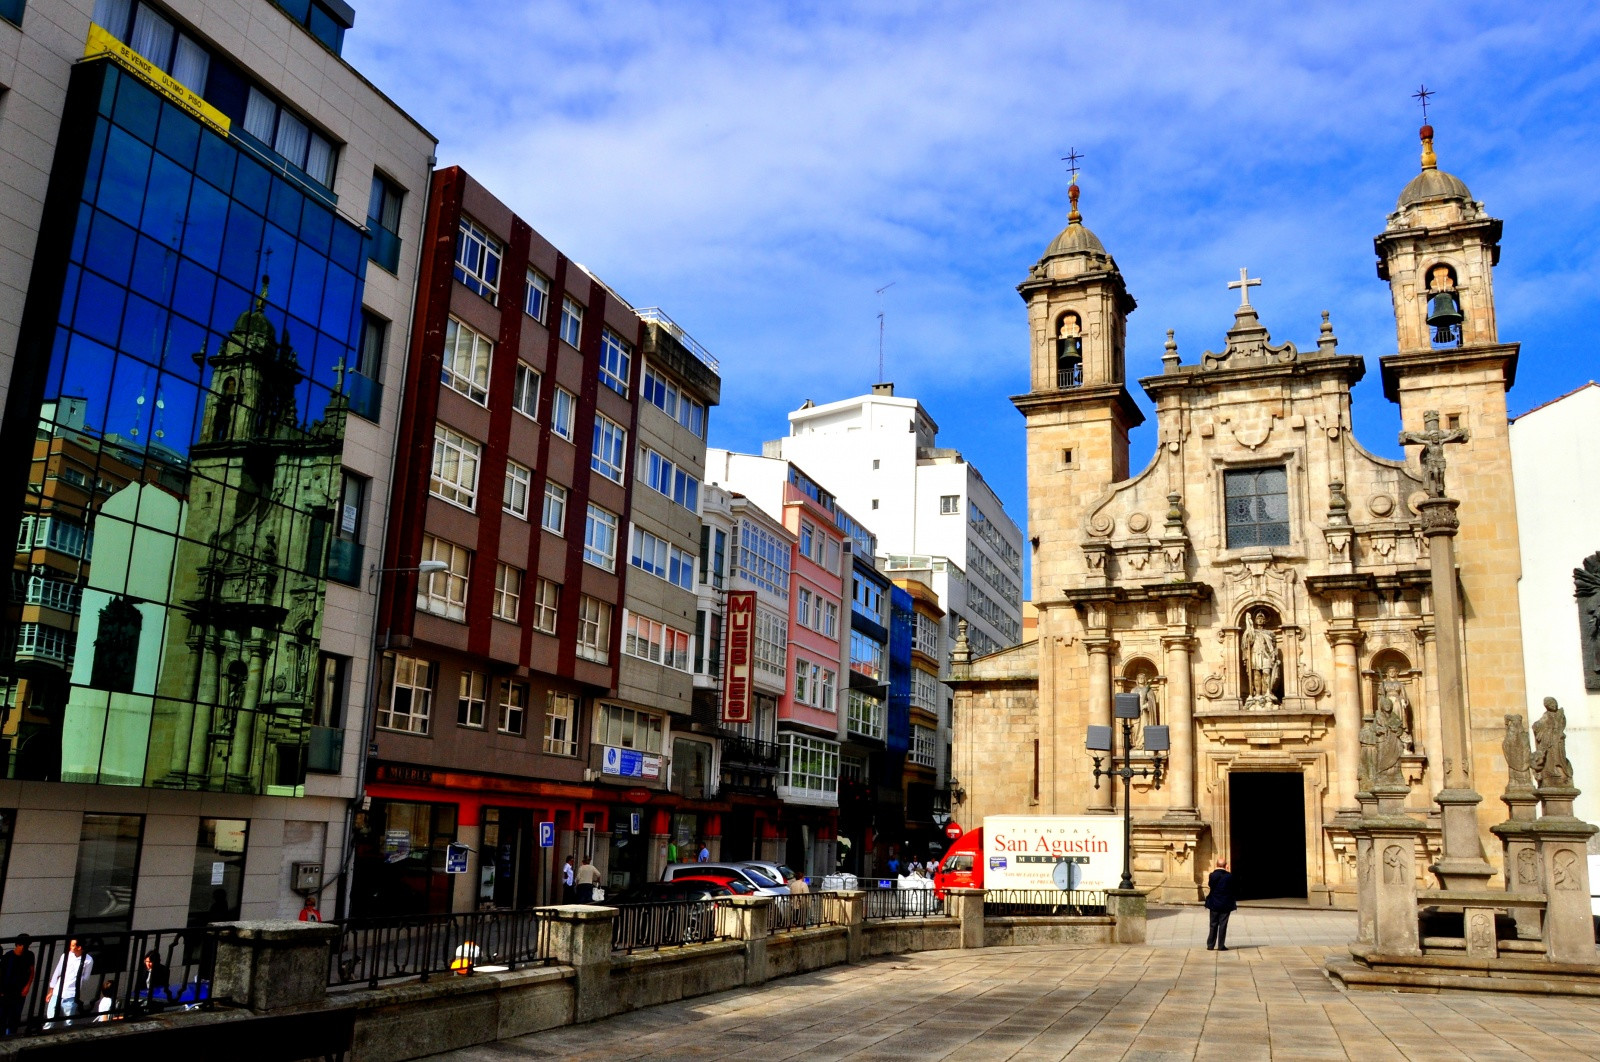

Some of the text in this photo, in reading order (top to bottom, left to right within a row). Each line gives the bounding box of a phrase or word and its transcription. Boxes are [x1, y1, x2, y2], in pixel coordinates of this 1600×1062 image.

[121, 47, 202, 109] SE VENDE ÚLTIMO PISO
[728, 596, 752, 718] MUEBLES
[542, 825, 551, 844] P
[994, 834, 1109, 858] San Agustín
